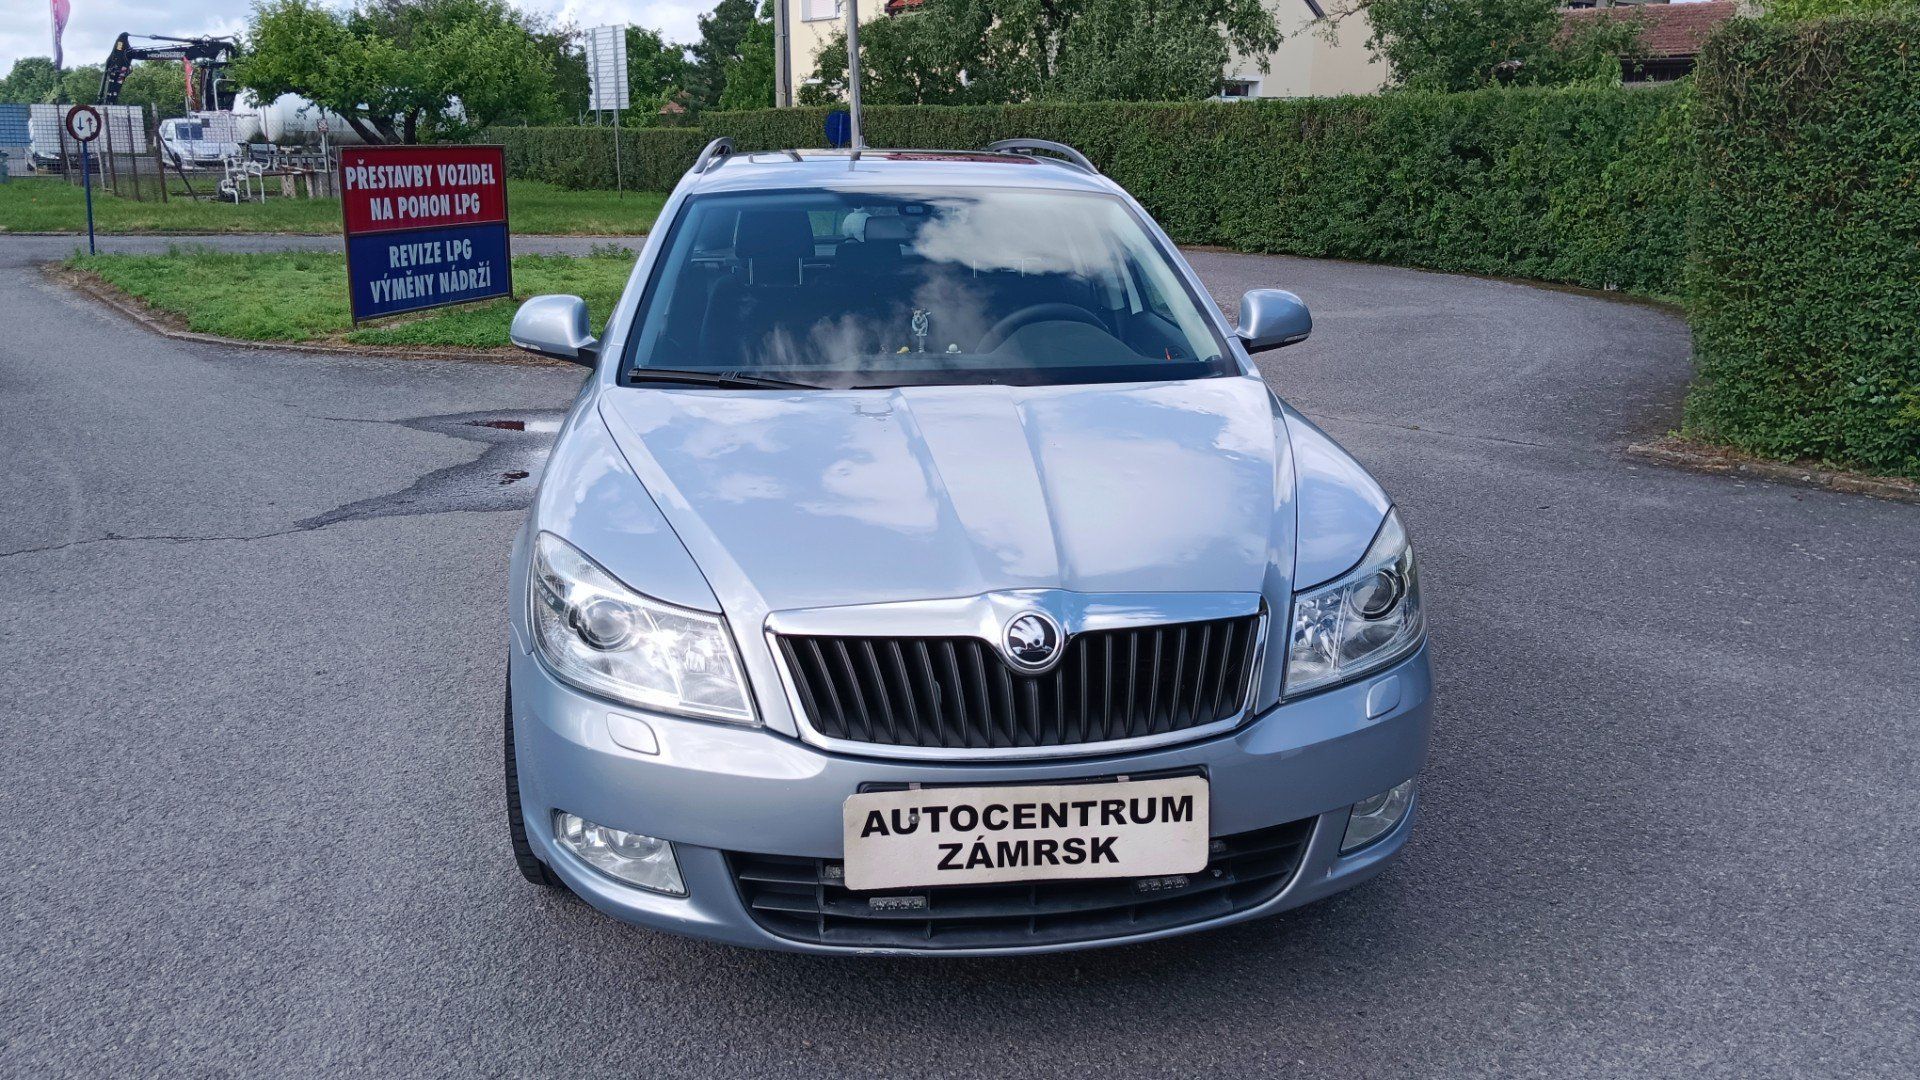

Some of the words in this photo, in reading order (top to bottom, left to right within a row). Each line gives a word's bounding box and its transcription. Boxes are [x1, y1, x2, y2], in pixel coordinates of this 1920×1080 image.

[345, 159, 433, 190] PŘESTAVBY
[437, 163, 496, 186] VOZIDEL
[370, 197, 394, 221] NA
[398, 194, 450, 219] POHON
[454, 192, 480, 215] LPG
[389, 241, 441, 268] REVIZE
[446, 238, 472, 261] LPG
[370, 269, 434, 303] VÝMĚNY
[439, 260, 491, 294] NÁDRŽÍ
[860, 795, 1194, 838] AUTOCENTRUM
[936, 834, 1120, 871] ZÁMRSK
